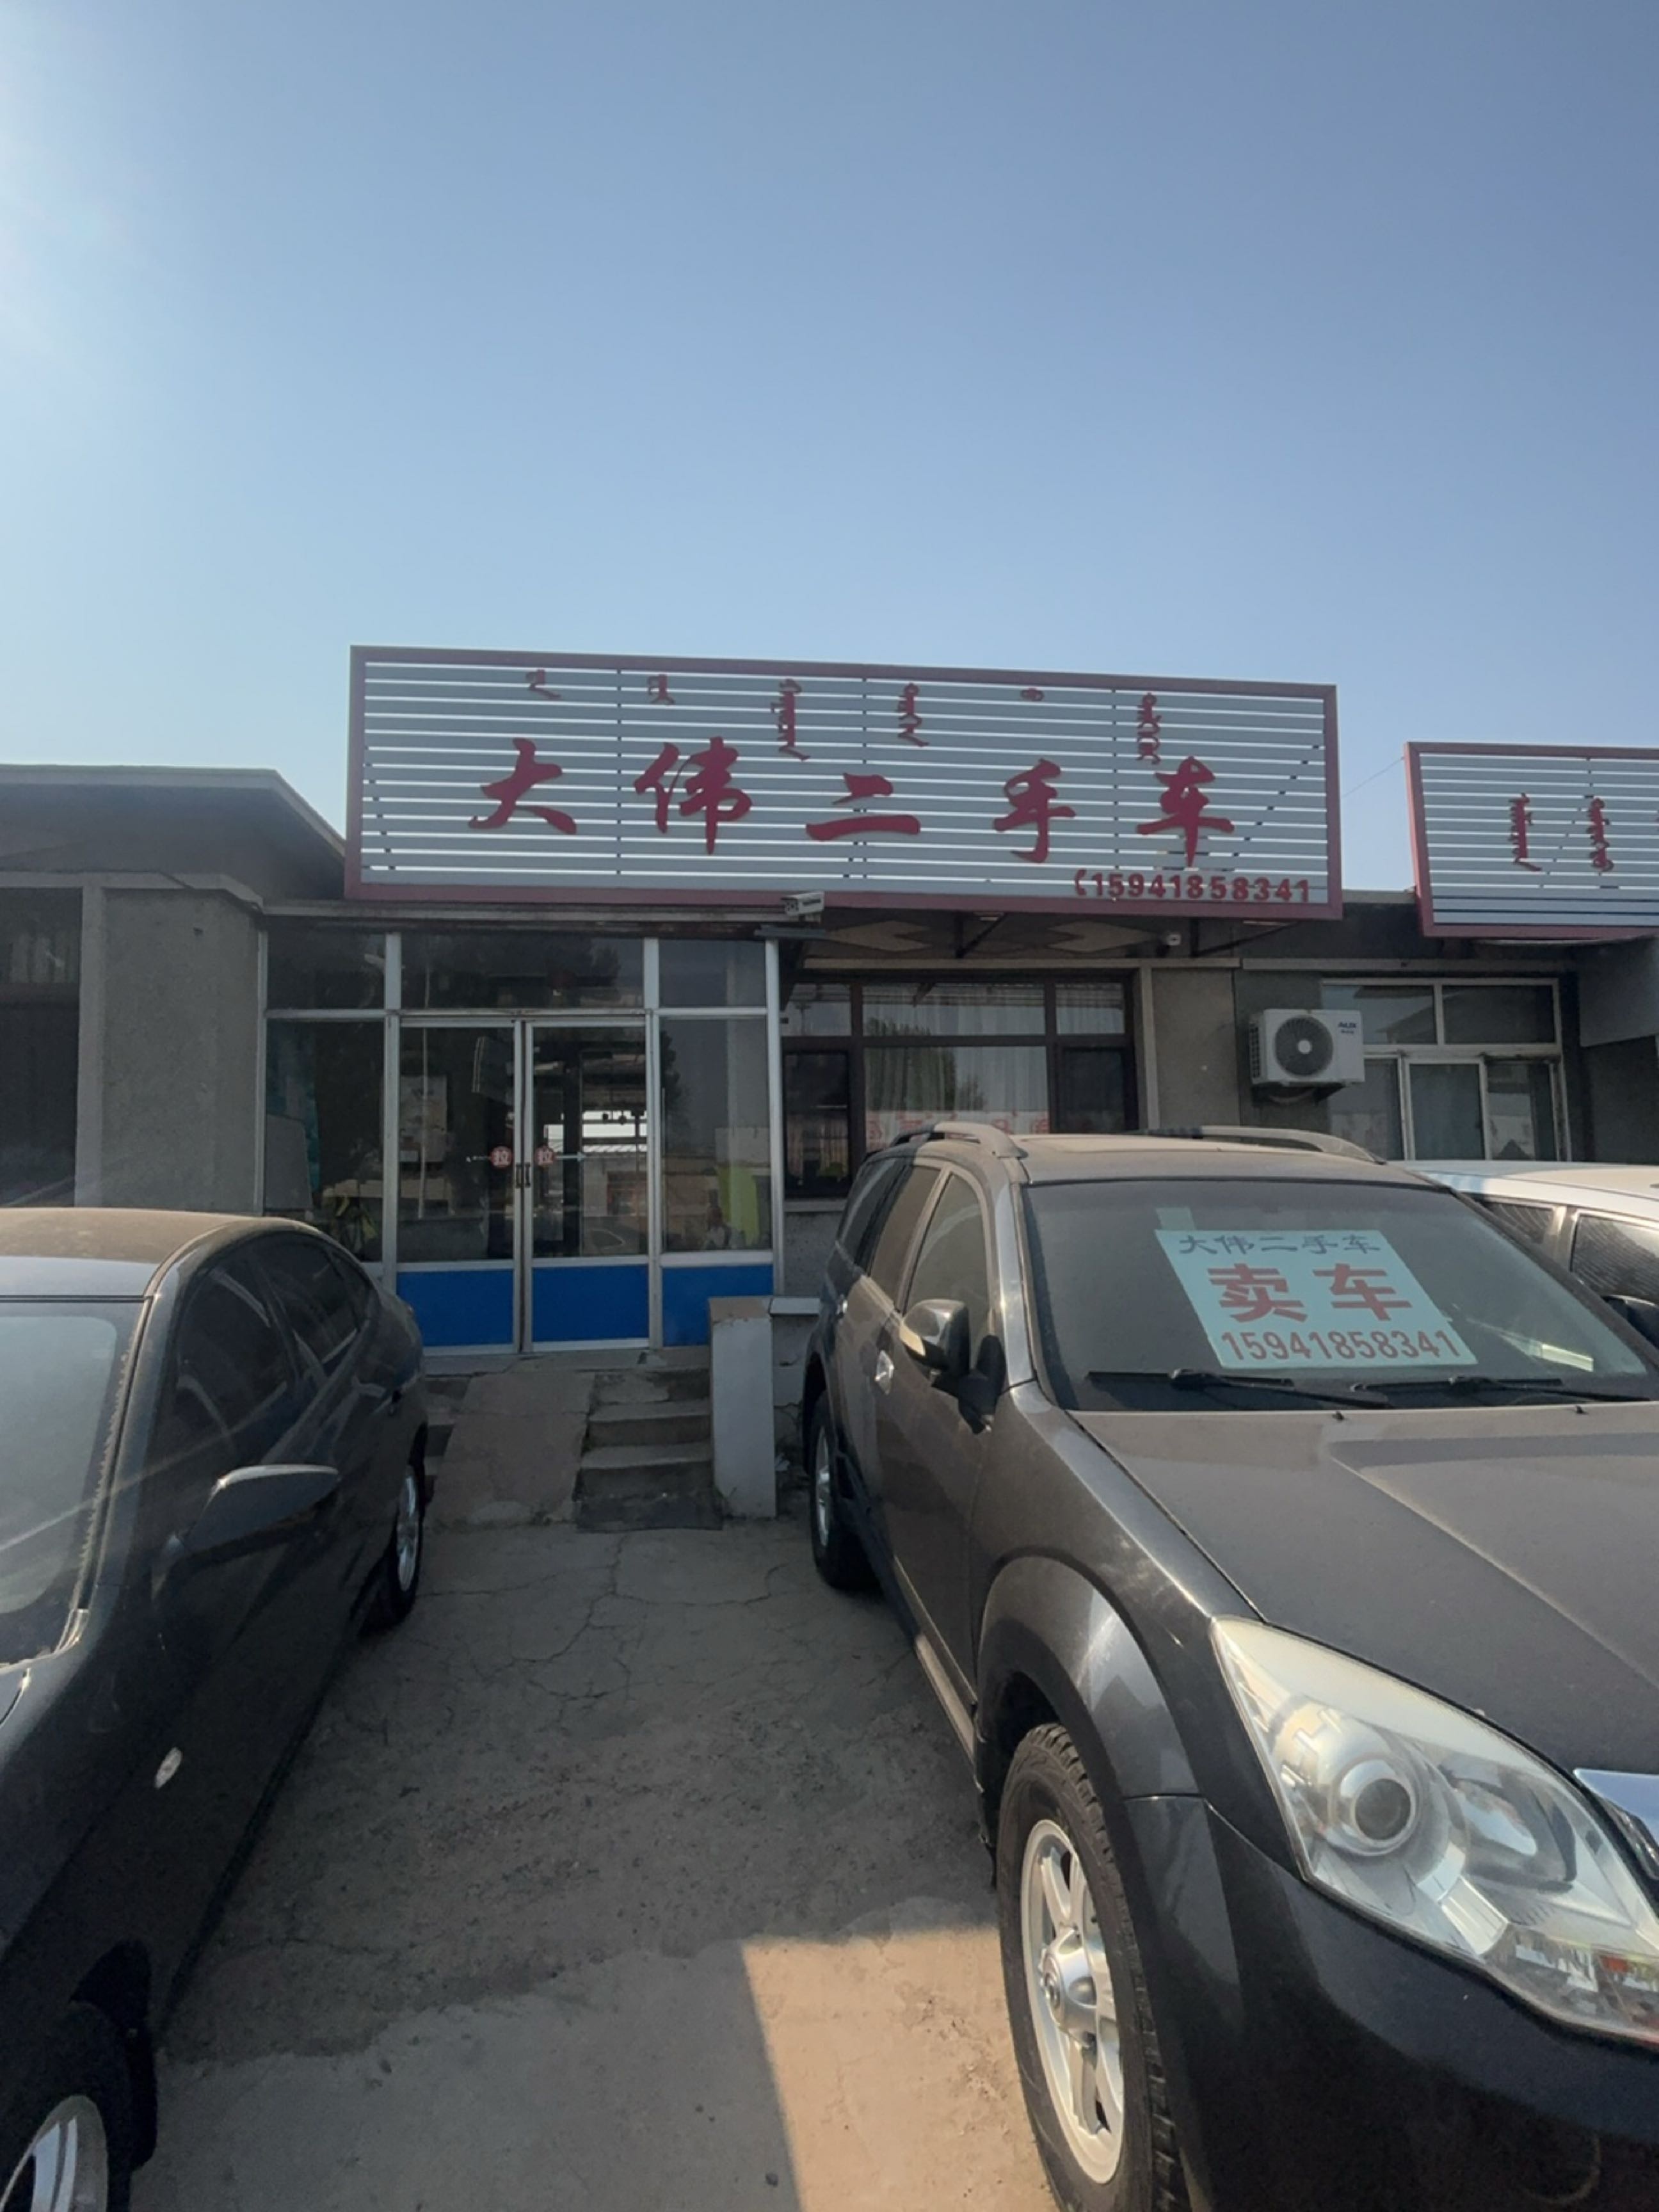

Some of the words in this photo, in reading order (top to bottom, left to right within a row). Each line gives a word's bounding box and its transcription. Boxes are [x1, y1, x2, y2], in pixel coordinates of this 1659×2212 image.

[468, 737, 1234, 867] 大伟二手车
[1091, 872, 1309, 902] 15941858341
[1179, 1235, 1380, 1254] 大伟二手车
[1207, 1263, 1412, 1322] 卖车
[1221, 1330, 1460, 1361] 15941858341
